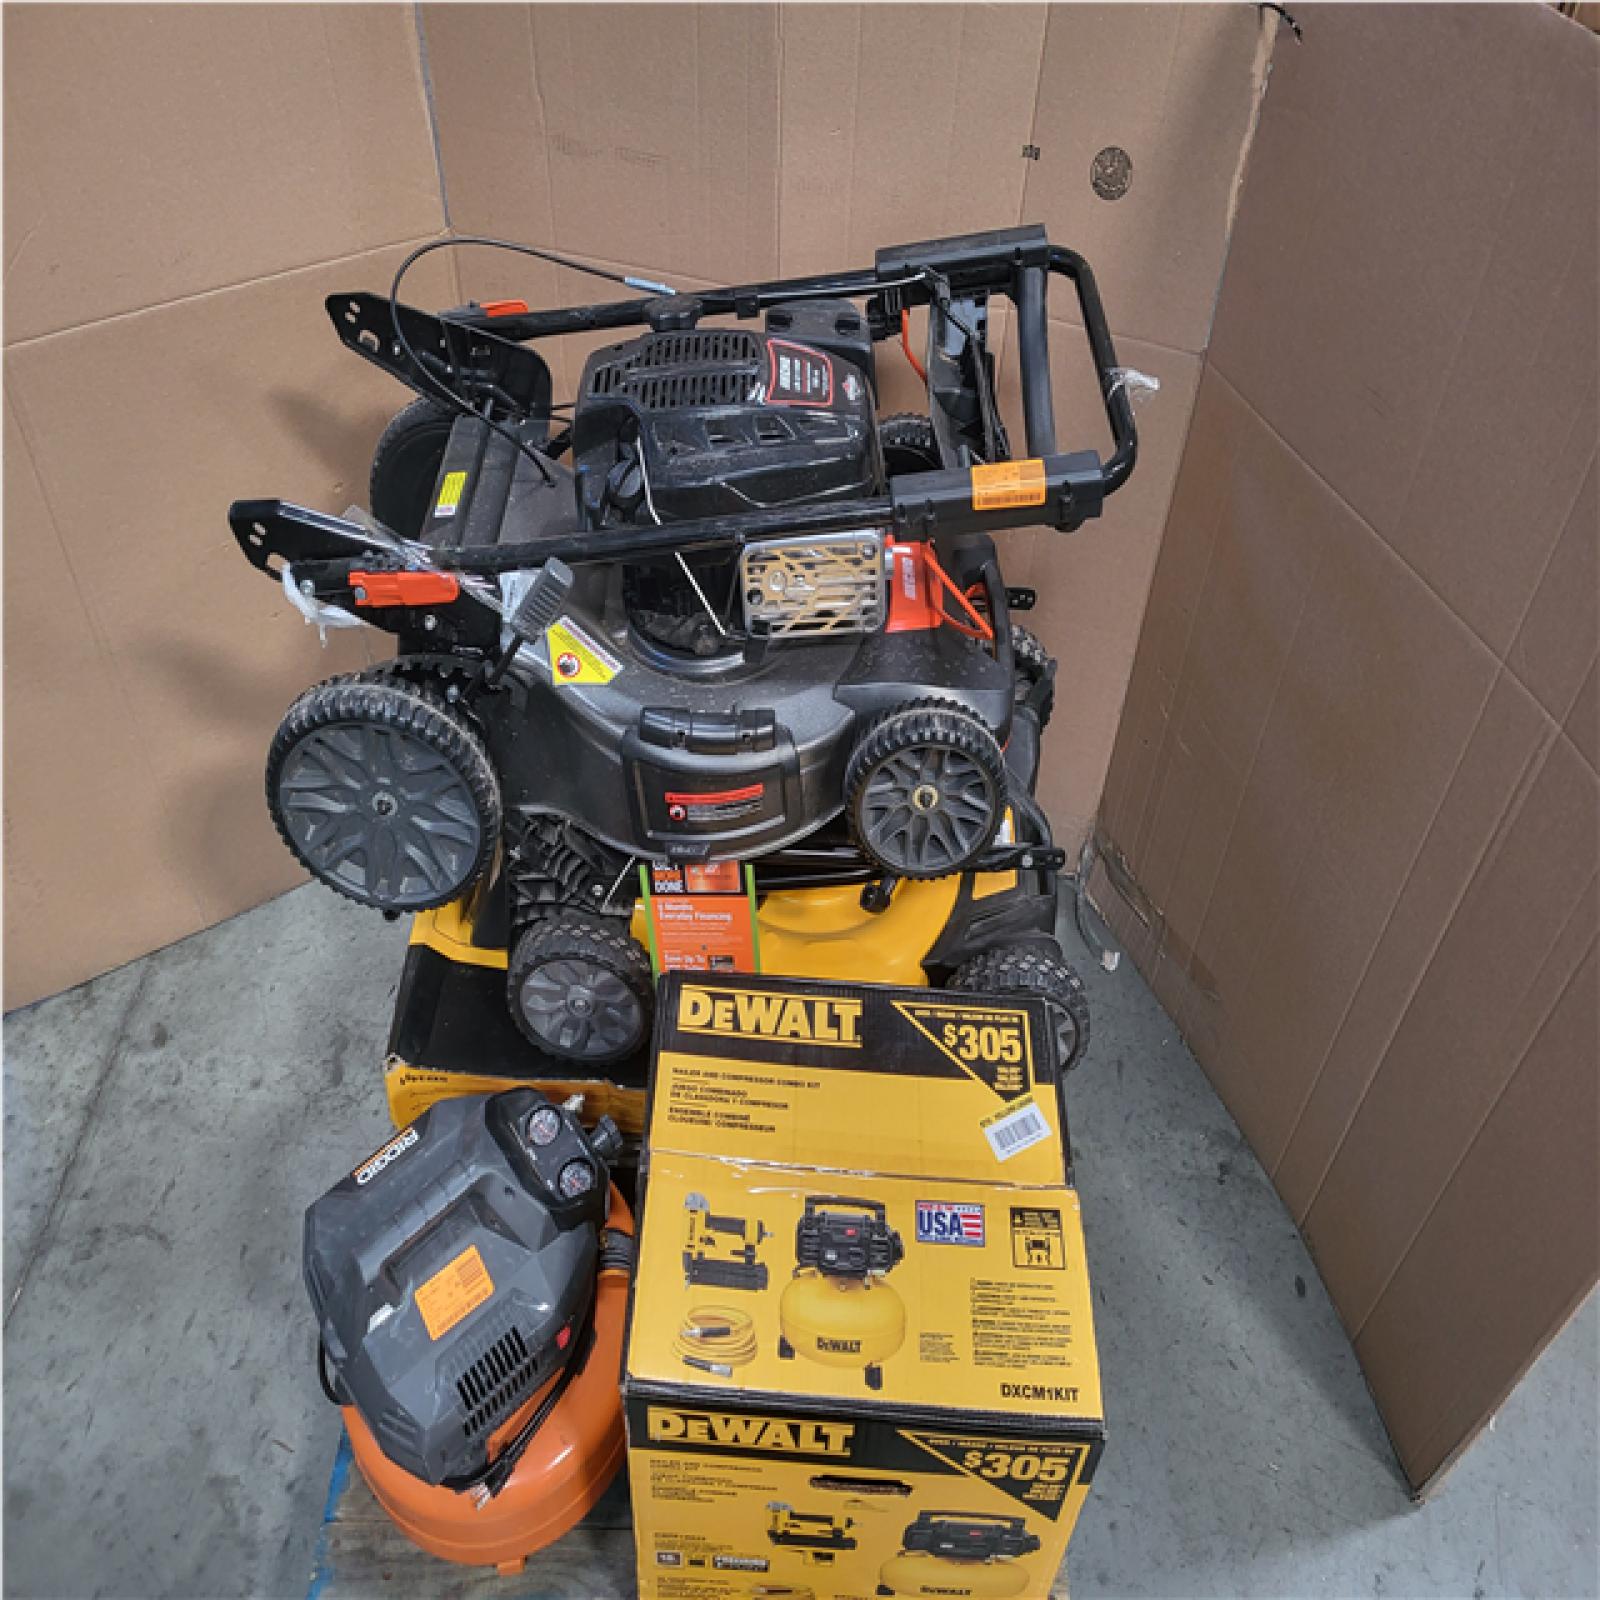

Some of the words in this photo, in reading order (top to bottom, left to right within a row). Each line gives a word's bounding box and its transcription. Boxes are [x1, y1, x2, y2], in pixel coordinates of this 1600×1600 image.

[944, 1022, 1022, 1063] $305
[919, 1210, 964, 1236] USA
[1000, 1383, 1079, 1403] DXCM1KIT
[964, 1449, 1071, 1481] $305
